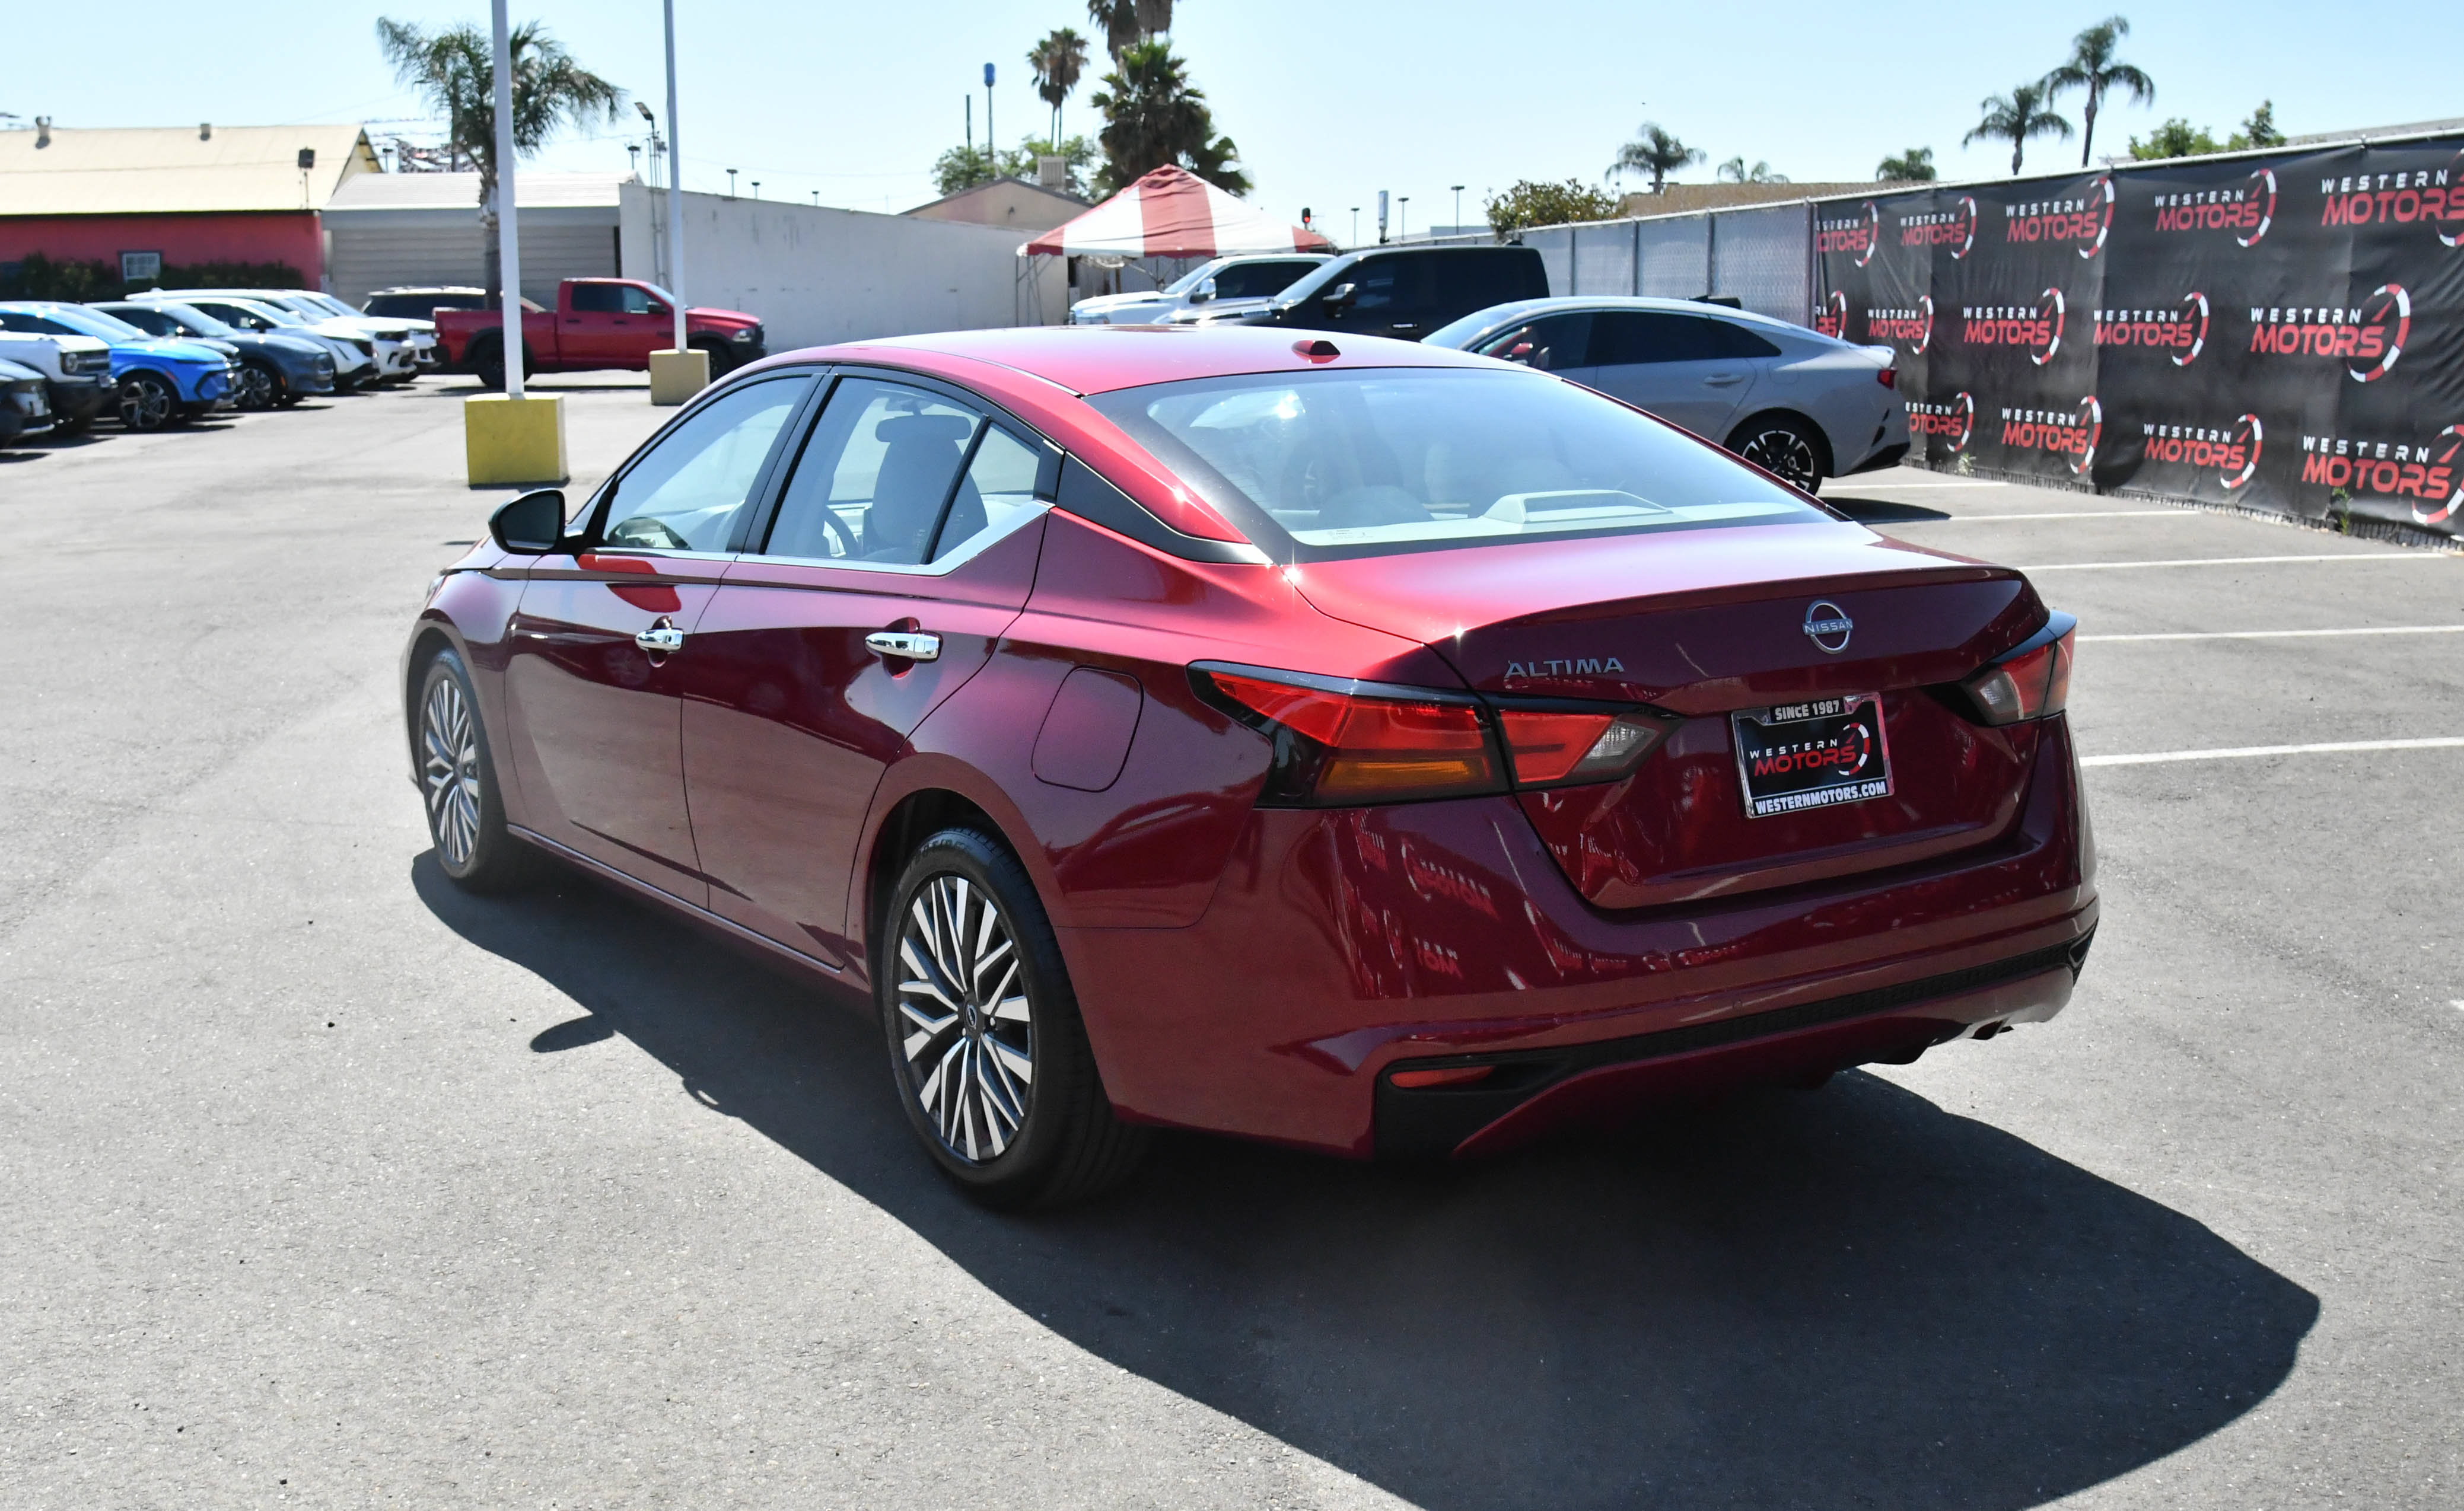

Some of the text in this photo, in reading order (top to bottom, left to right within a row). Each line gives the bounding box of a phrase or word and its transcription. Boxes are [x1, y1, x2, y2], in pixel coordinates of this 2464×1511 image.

[2321, 169, 2448, 194] WESTERN
[2005, 199, 2085, 218] WESTERN
[2155, 189, 2244, 207] WESTERN
[2321, 186, 2464, 225] MOTORS
[1817, 218, 1859, 231] ESTERN
[1900, 213, 1955, 228] WESTERN
[2007, 211, 2098, 241] MOTORS
[2155, 202, 2259, 230] MOTORS
[1817, 229, 1867, 251] OTORS
[1900, 222, 1965, 245] MOTORS
[1867, 308, 1917, 320] WESTERN
[1963, 307, 2038, 320] WESTERN
[2093, 309, 2179, 324] WESTERN
[2250, 307, 2362, 324] WESTERN
[1869, 319, 1924, 339] MOTORS
[1964, 319, 2051, 346] MOTORS
[2094, 322, 2193, 347] MOTORS
[2250, 320, 2385, 358] MOTORS
[1905, 401, 1952, 415] ESTERN
[2002, 407, 2077, 427] WESTERN
[1910, 411, 1963, 436] OTORS
[2144, 423, 2231, 444] WESTERN
[2002, 422, 2088, 454] MOTORS
[2303, 435, 2430, 463] WESTERN
[2144, 433, 2247, 470] MOTORS
[2301, 450, 2453, 500] MOTORS
[1804, 621, 1853, 633] NISSAN
[1504, 657, 1625, 679] ALTIMA
[1775, 700, 1839, 721] SINCE 1987
[1750, 739, 1838, 759] WESTERN
[1754, 745, 1856, 777] MOTORS
[1755, 781, 1886, 814] WESTERNMOTORS.COM
